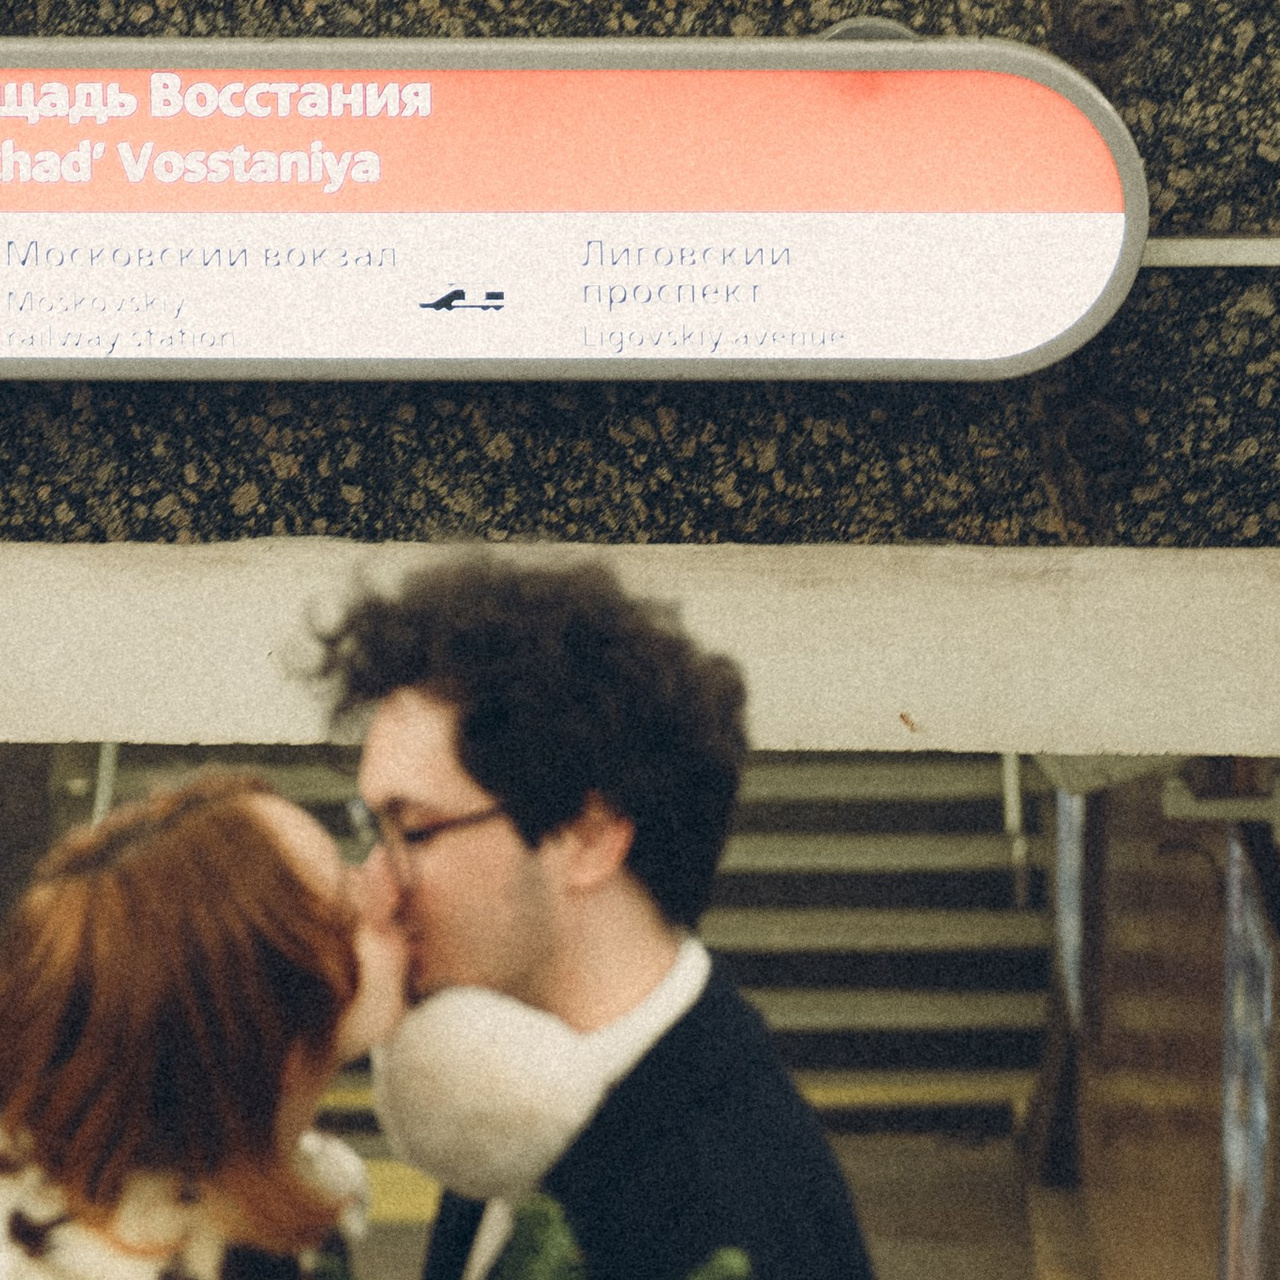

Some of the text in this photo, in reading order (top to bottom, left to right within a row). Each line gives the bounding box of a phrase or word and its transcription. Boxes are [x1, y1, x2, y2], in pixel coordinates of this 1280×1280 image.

[150, 72, 431, 117] Восстания
[117, 140, 381, 194] Vosstaniya
[265, 248, 397, 267] вокзал
[584, 284, 762, 312] проспект
